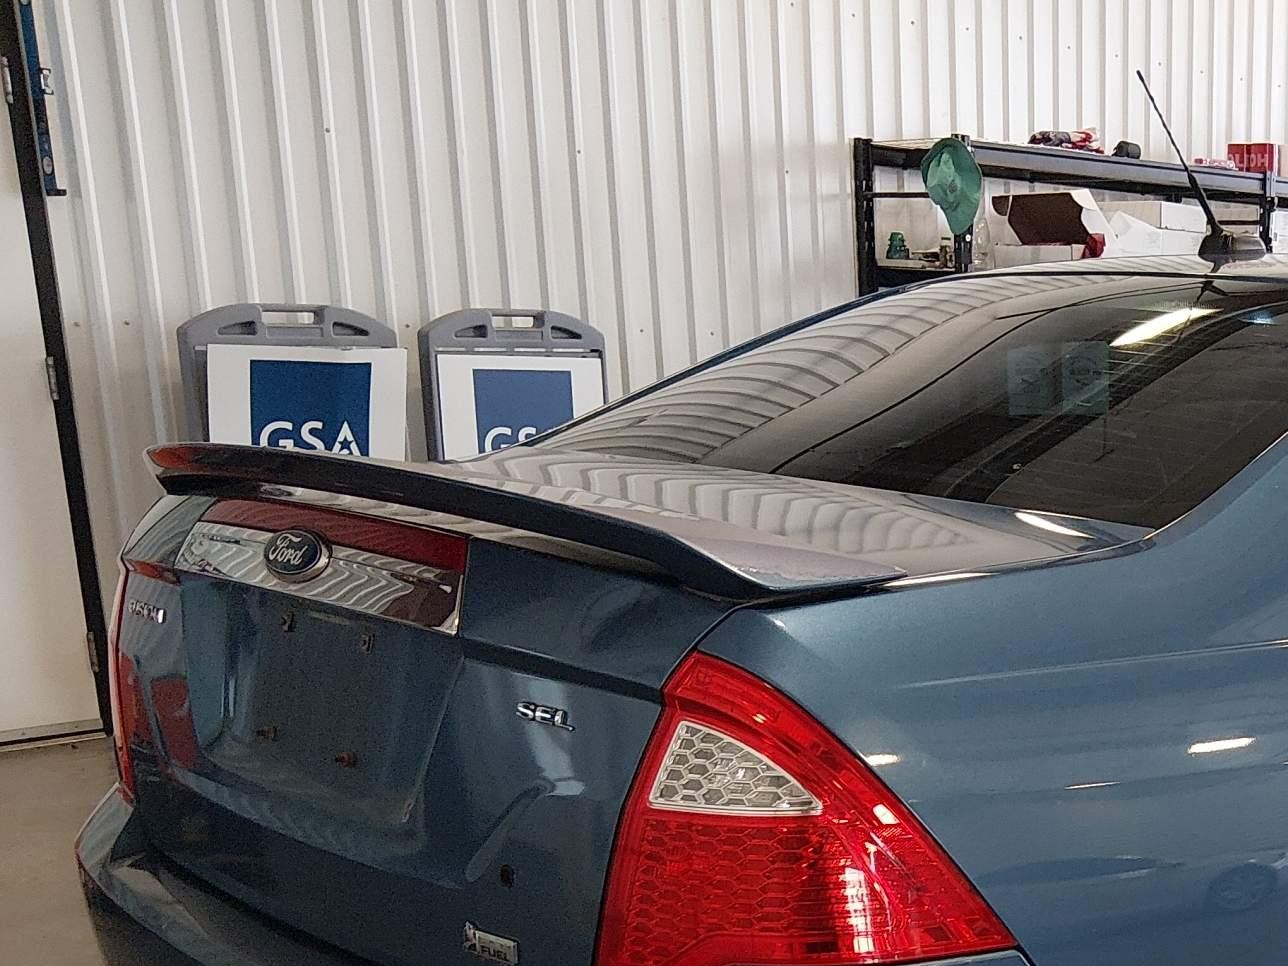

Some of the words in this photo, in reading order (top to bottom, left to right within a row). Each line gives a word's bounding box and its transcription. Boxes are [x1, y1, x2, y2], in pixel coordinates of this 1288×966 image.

[260, 420, 361, 457] GSA
[269, 533, 308, 565] Ford
[516, 702, 574, 731] SEL
